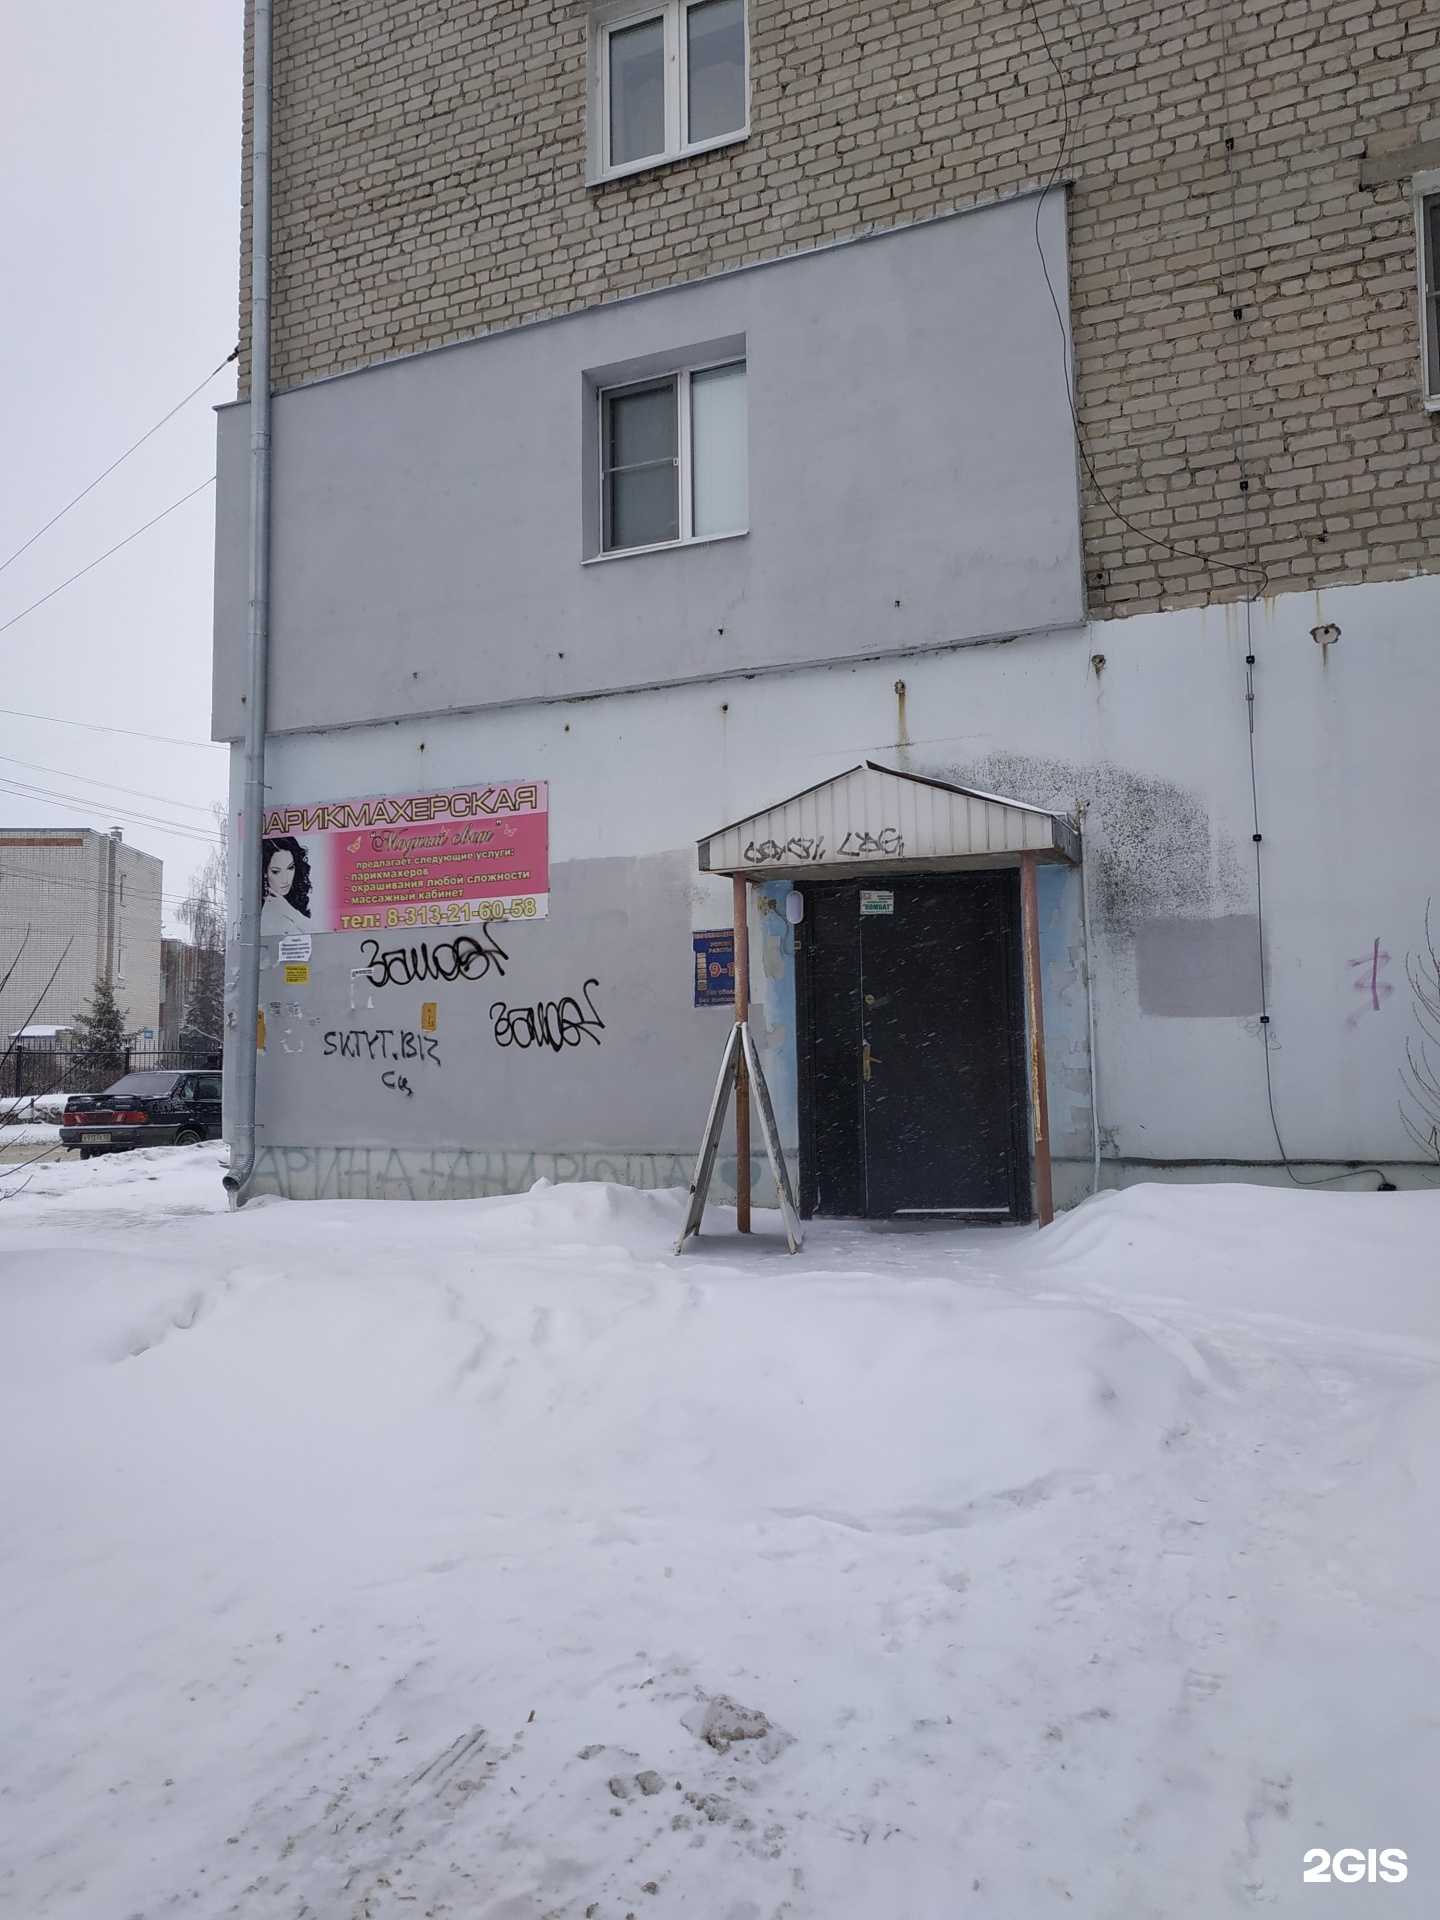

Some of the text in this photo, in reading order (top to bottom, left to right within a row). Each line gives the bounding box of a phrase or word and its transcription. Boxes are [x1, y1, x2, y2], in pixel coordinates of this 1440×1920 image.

[262, 784, 537, 836] АРИКМАХЕРСКАЯ
[356, 857, 411, 871] предлагает
[476, 847, 514, 860] услуги:
[427, 875, 464, 887] любой
[467, 870, 529, 884] сложности
[418, 887, 464, 901] кабинет
[341, 896, 538, 930] тел: 8-313-21-60-58
